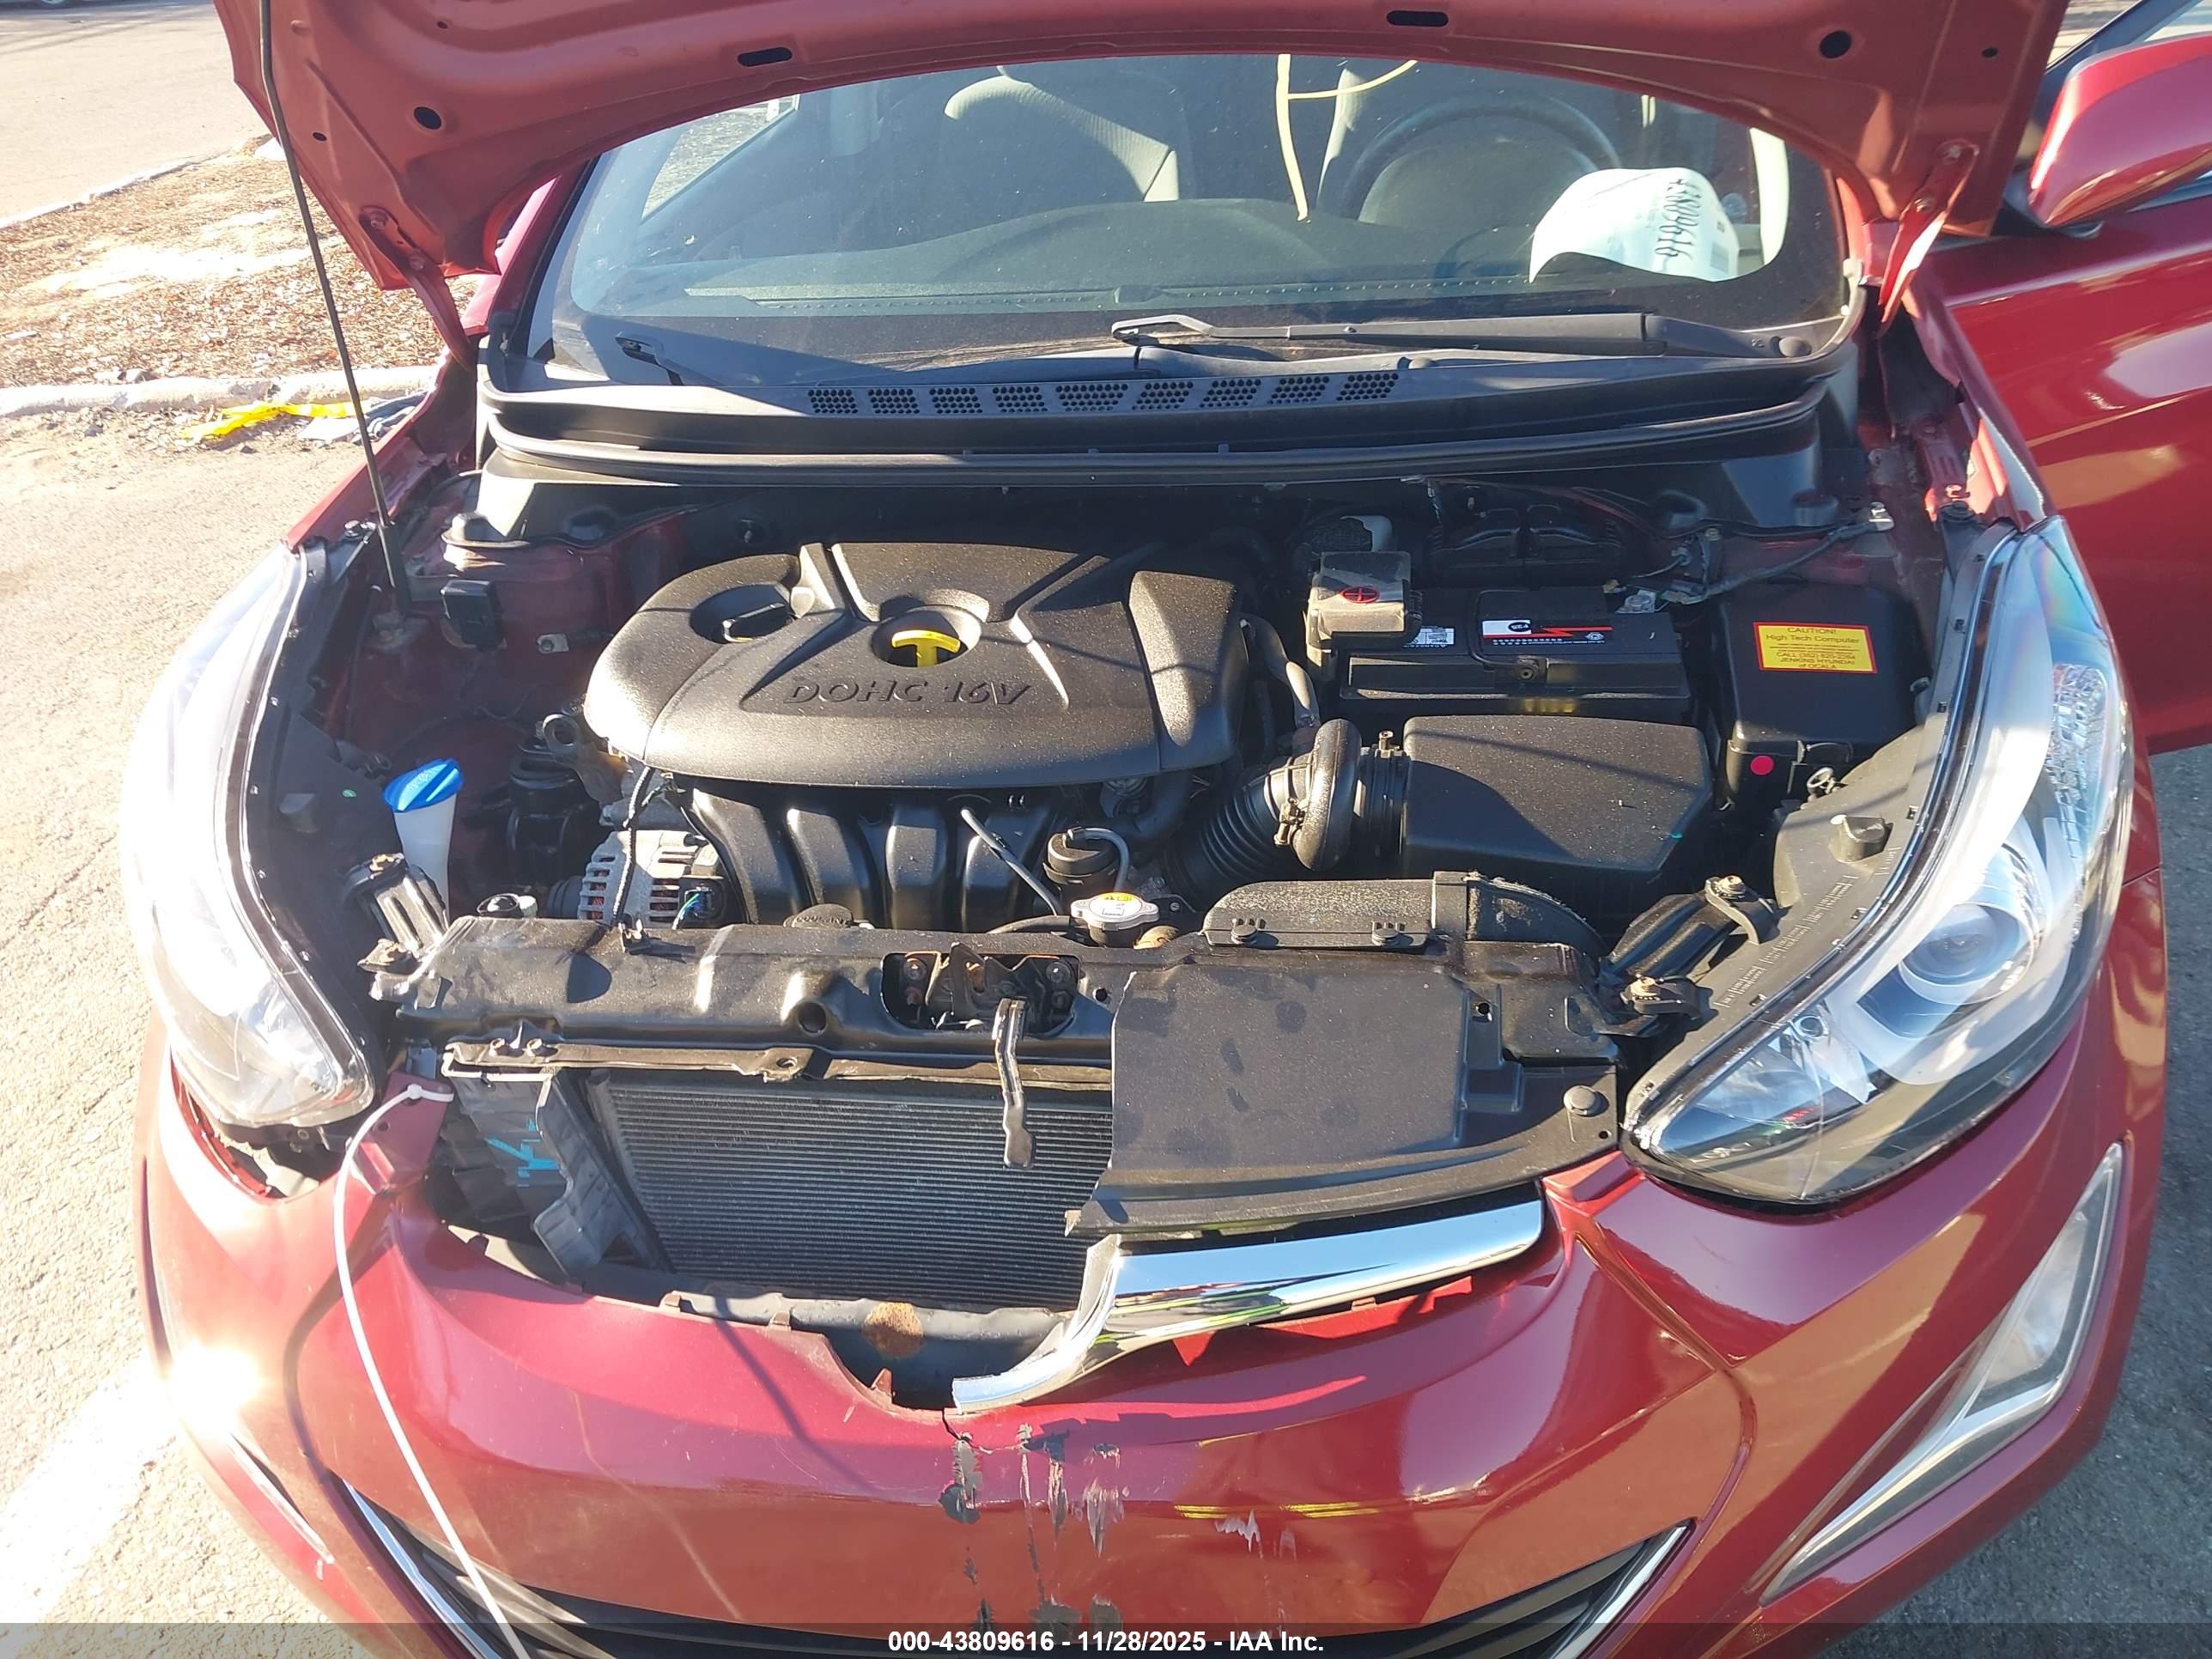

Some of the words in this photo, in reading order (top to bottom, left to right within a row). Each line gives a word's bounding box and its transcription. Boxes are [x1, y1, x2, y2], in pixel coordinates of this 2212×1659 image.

[1814, 635, 1860, 644] Computer
[783, 680, 928, 704] DOHC
[945, 681, 1031, 705] 16V
